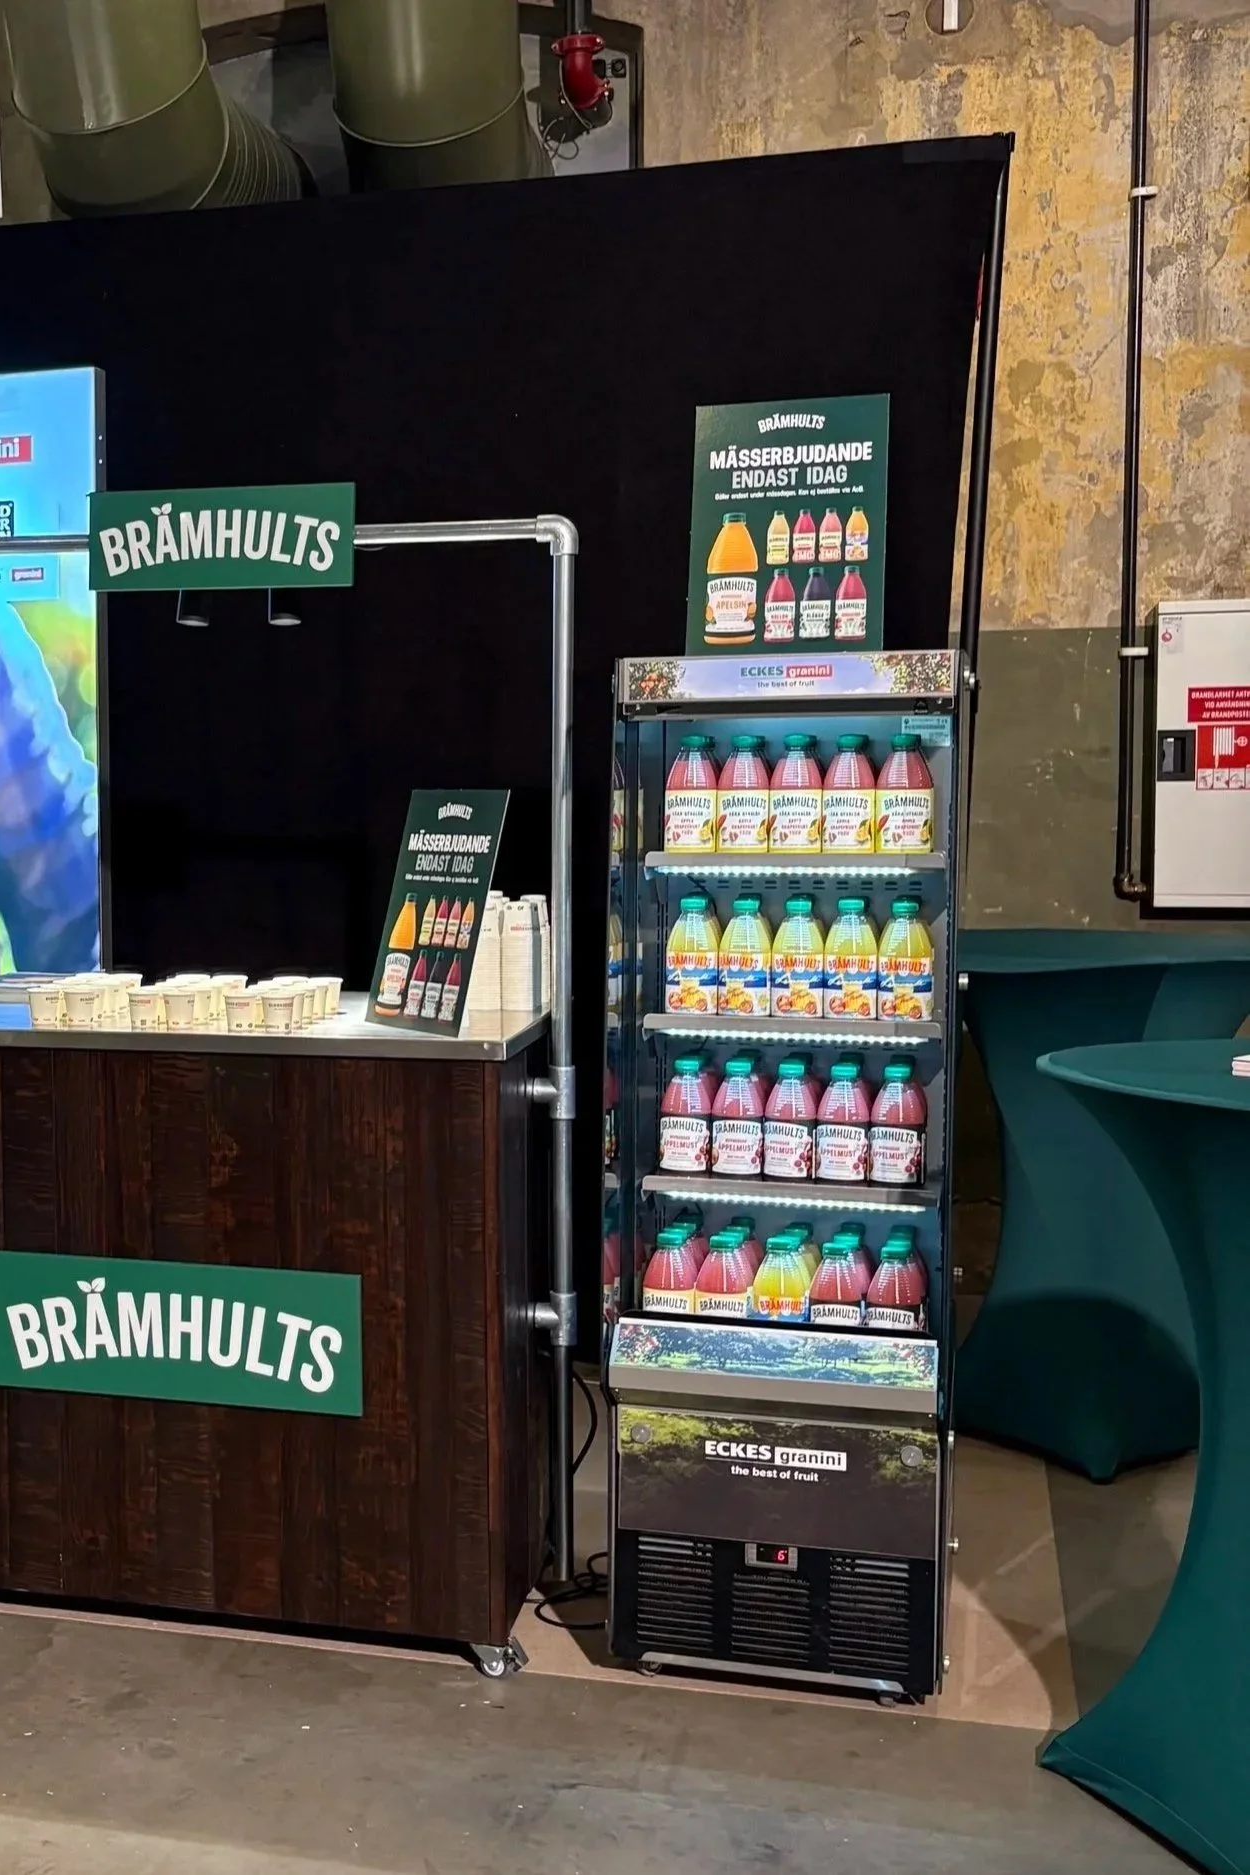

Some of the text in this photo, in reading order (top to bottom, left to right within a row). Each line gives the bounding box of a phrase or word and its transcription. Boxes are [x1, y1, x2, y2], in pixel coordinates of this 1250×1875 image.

[757, 412, 826, 434] BRÄMHULTS
[709, 440, 873, 471] MÄSSERBJUDANDE
[731, 464, 848, 489] ENDAST IDAG
[98, 502, 341, 578] BRÄMHULTS
[709, 579, 755, 595] BRÄMHULTS
[740, 664, 831, 678] ECKES granini
[407, 829, 492, 854] MÄSSERBJUDANDE
[415, 853, 475, 874] ENDAST IDAG
[6, 1277, 343, 1393] BRÄMHULTS
[704, 1439, 842, 1467] ECKES granini
[730, 1464, 820, 1482] the best of fruit
